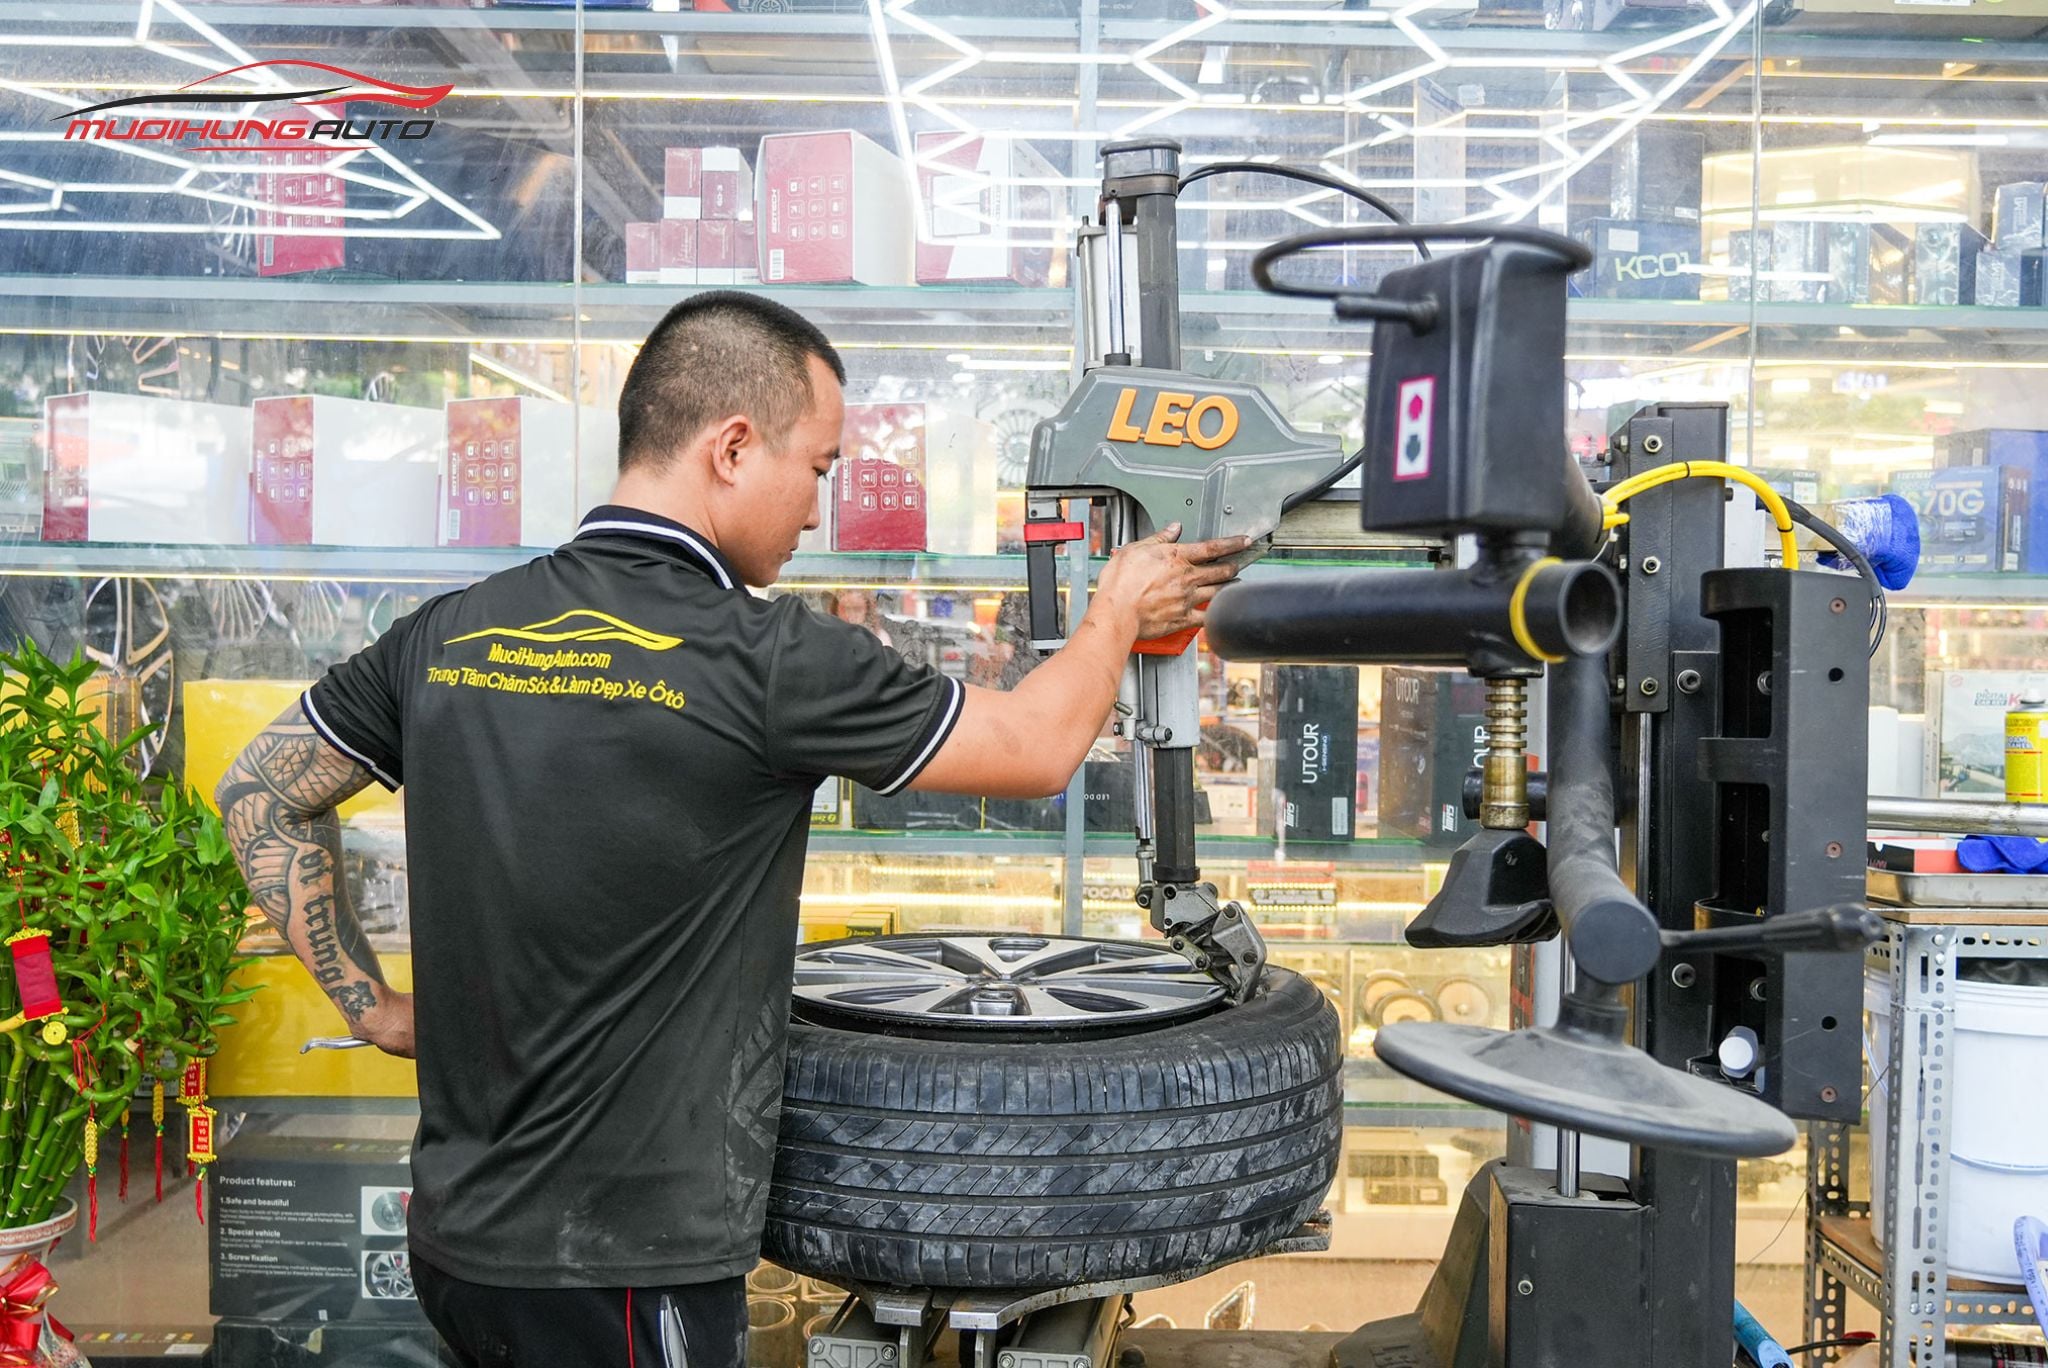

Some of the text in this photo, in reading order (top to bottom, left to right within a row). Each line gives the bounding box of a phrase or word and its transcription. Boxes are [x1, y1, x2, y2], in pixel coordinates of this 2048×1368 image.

[1106, 387, 1239, 450] LEO
[487, 642, 612, 671] MuoiHungAuto.com
[427, 666, 460, 687] Trung
[461, 667, 487, 689] Tâm
[487, 671, 529, 693] Chăm
[549, 677, 562, 694] &
[560, 675, 592, 695] Làm
[591, 676, 624, 701] Đẹp
[624, 680, 648, 699] Xe
[1302, 722, 1320, 784] UTOUR
[219, 1175, 296, 1188] Product features:
[242, 1197, 257, 1206] and
[257, 1198, 290, 1207] beautiful
[228, 1228, 254, 1238] Special
[254, 1229, 281, 1238] vehicle
[228, 1253, 250, 1262] Screw
[251, 1254, 278, 1262] fixation
